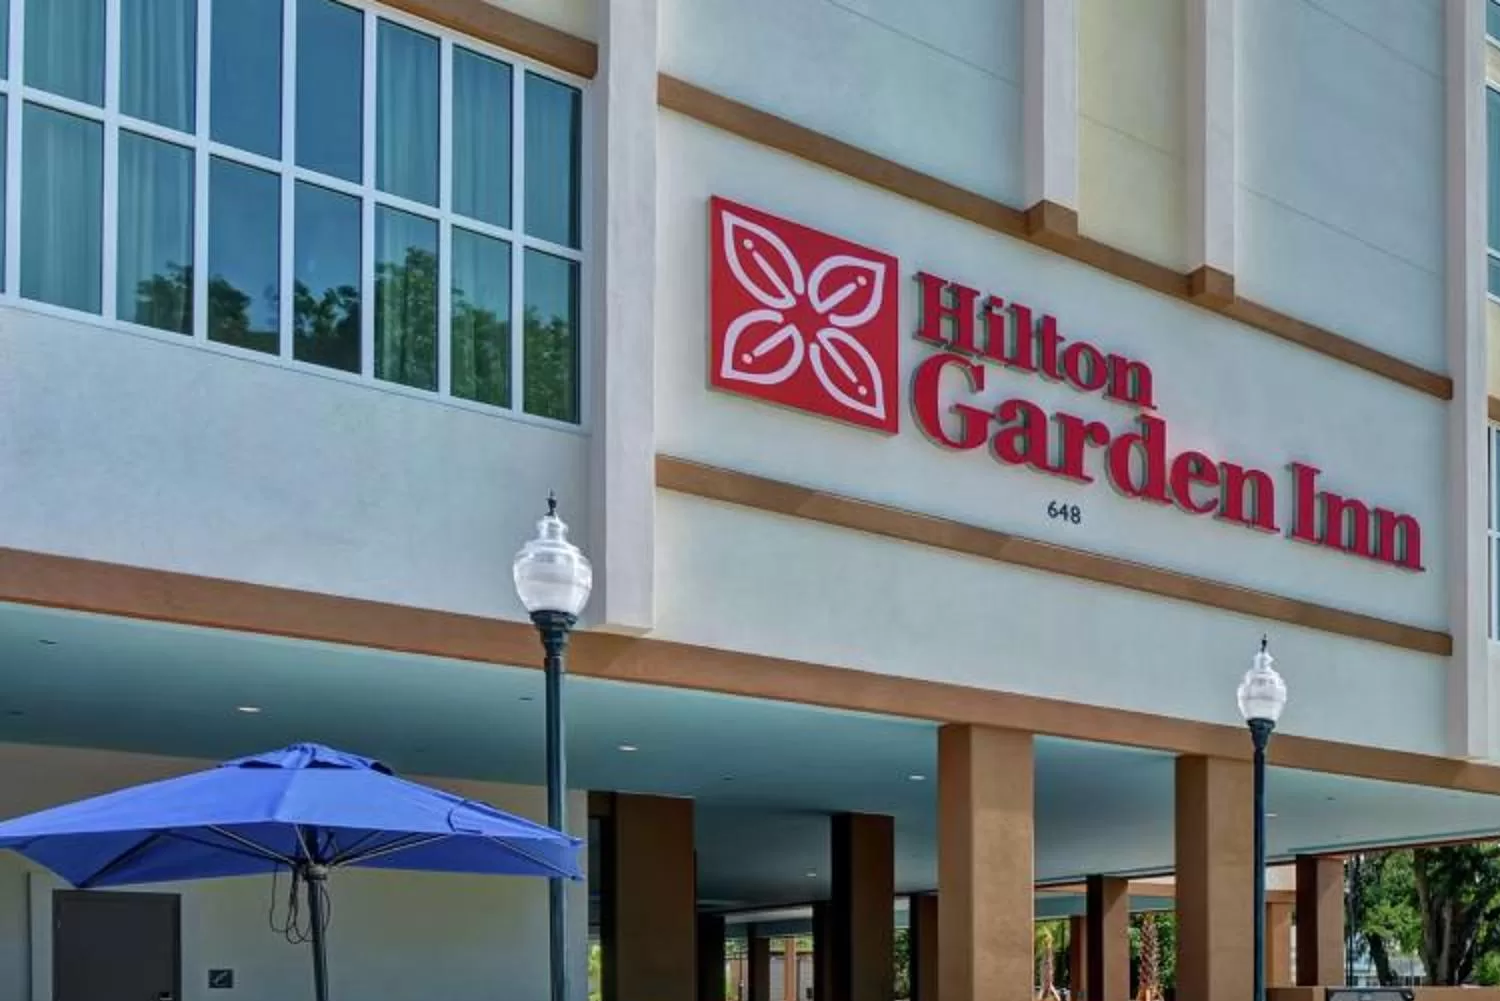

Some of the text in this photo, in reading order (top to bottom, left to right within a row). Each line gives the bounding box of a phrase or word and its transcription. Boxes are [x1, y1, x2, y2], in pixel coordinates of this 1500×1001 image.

[914, 271, 1157, 411] Hilton
[911, 352, 1426, 572] Garden Inn
[1047, 500, 1081, 525] 648
